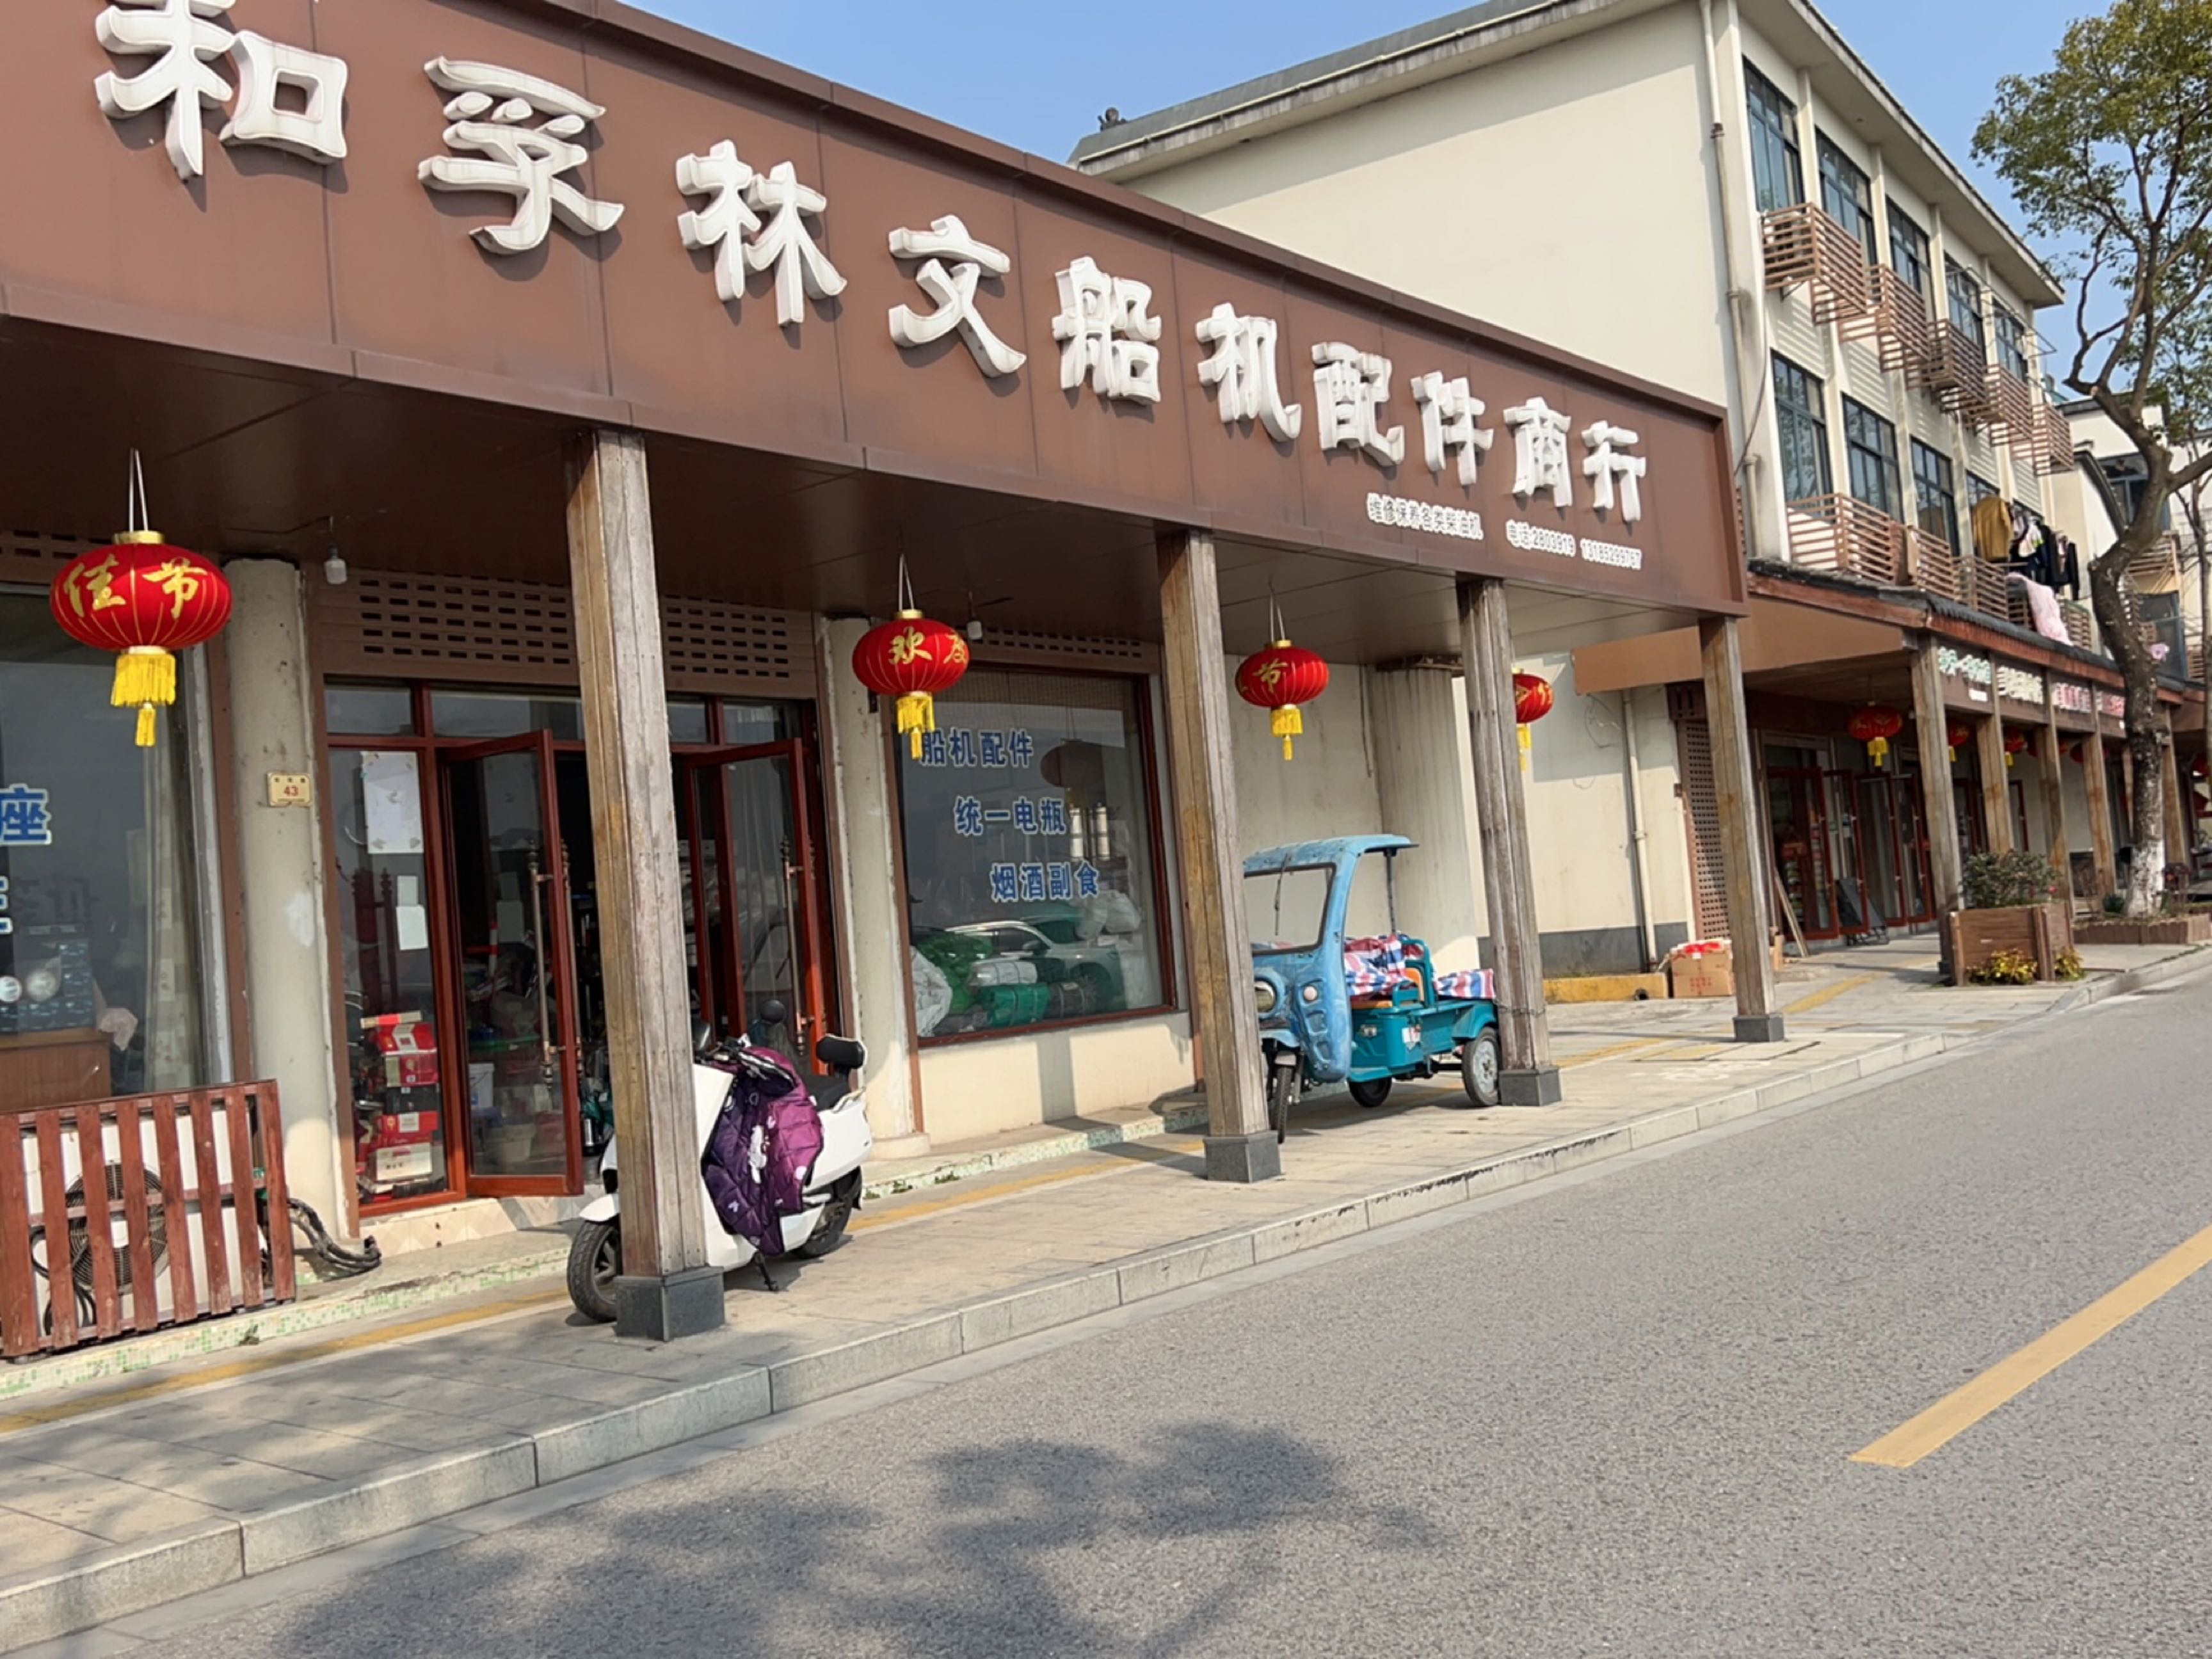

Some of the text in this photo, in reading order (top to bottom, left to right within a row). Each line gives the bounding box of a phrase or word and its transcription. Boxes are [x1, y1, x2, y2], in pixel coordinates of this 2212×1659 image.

[95, 0, 1647, 522] 和孚林文船机配件商行
[63, 553, 209, 619] 佳节
[919, 727, 1034, 767] 船机配件
[284, 785, 299, 797] 43
[954, 796, 1066, 837] 统一电瓶
[990, 860, 1100, 903] 烟酒副食
